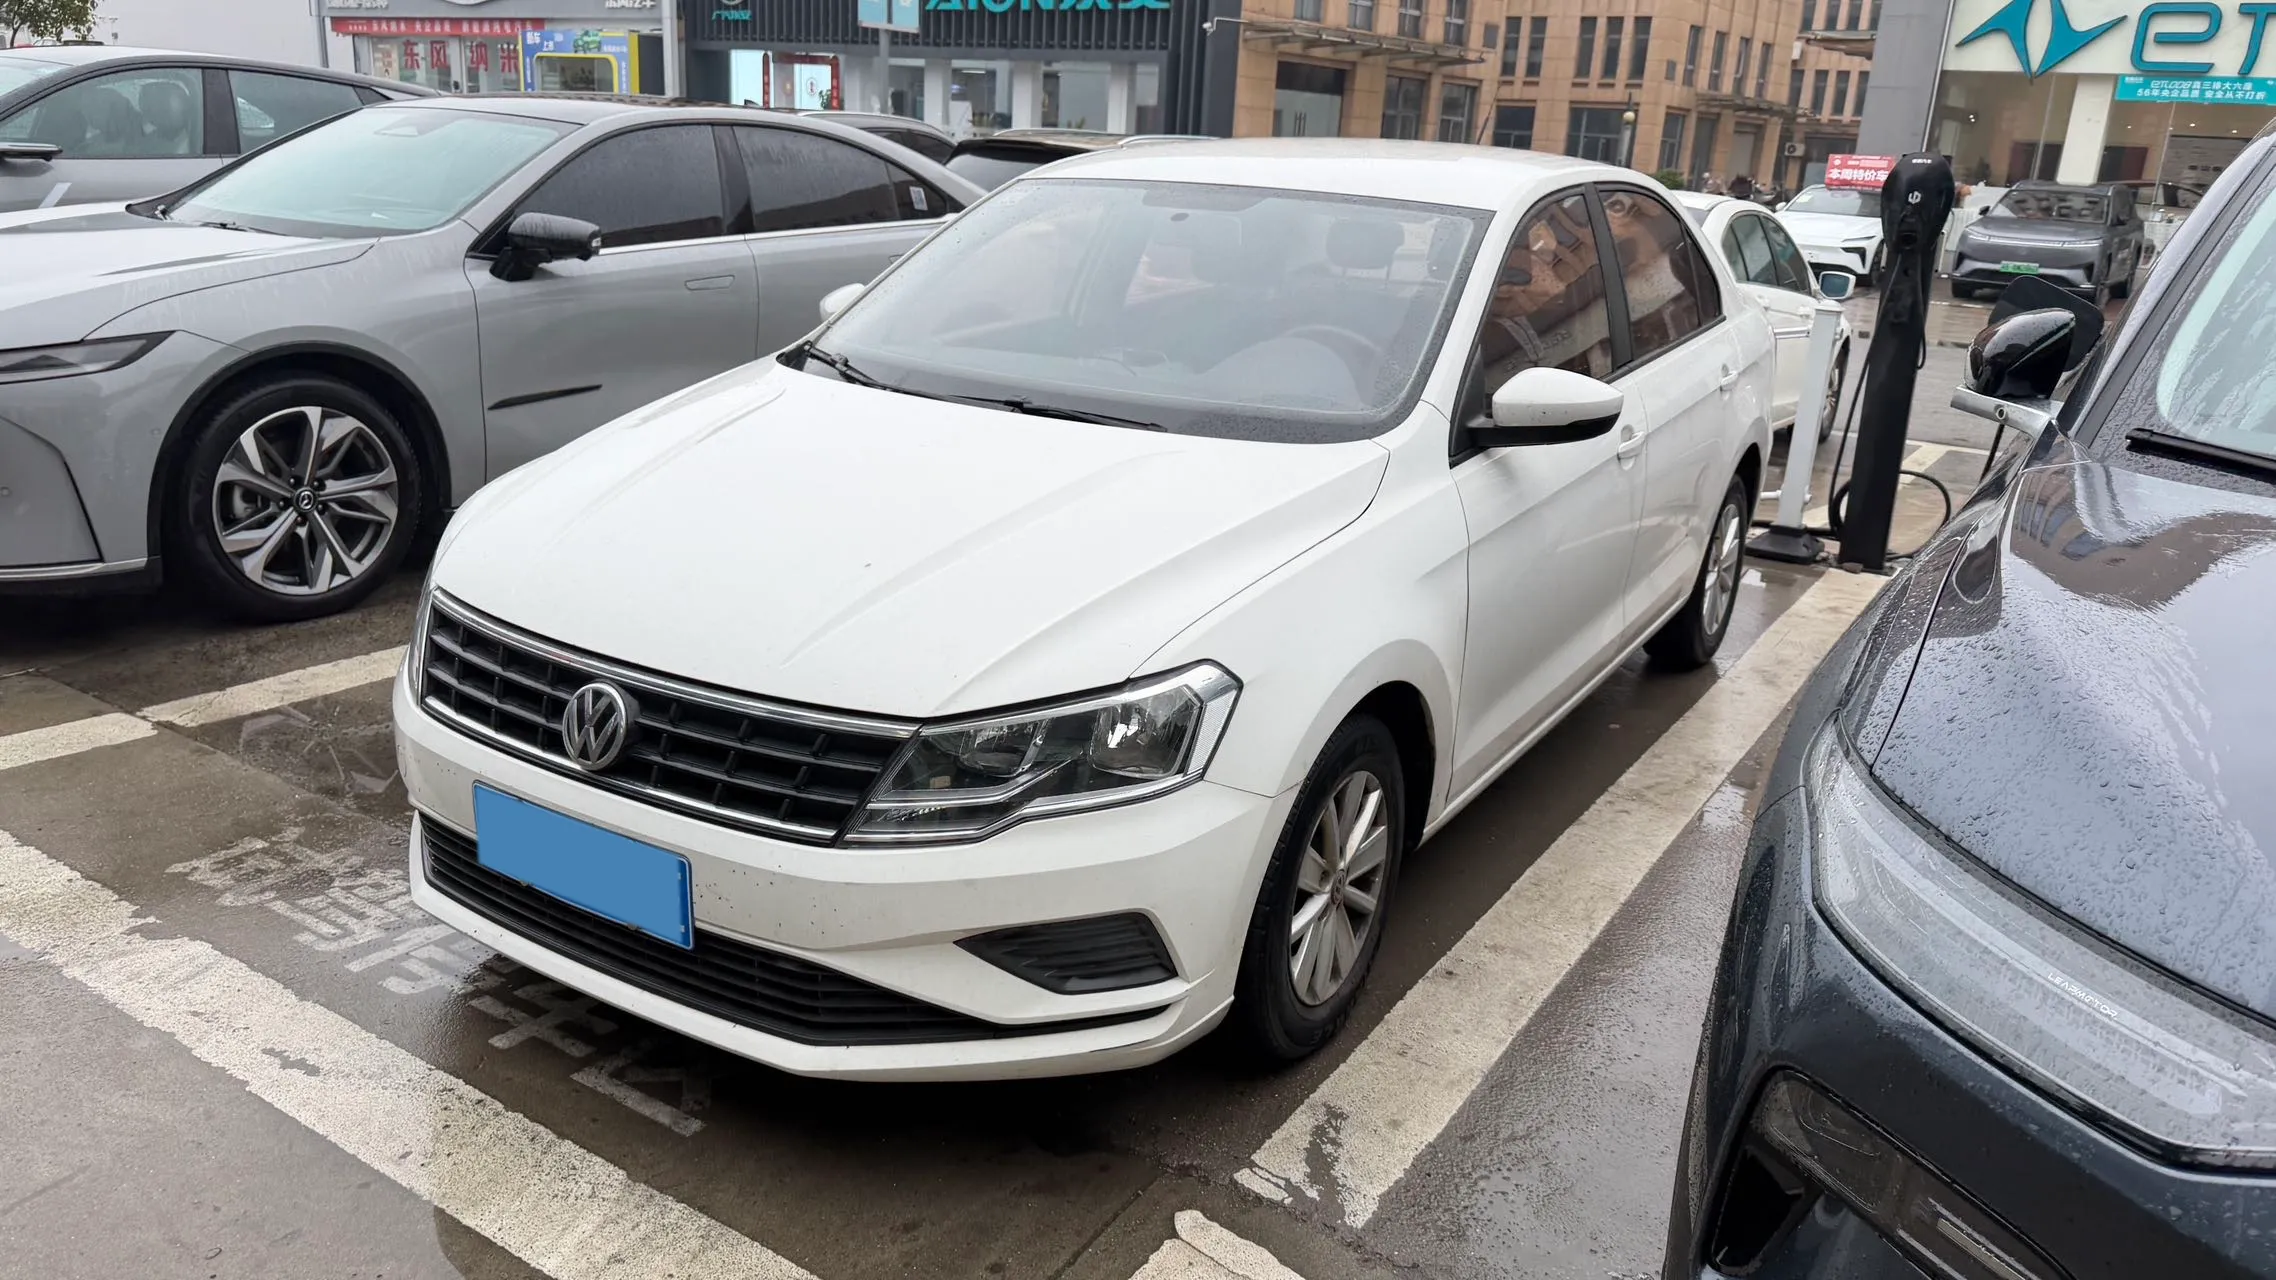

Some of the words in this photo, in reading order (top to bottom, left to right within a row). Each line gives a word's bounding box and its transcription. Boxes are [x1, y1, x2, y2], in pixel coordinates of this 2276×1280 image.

[403, 39, 519, 73] 东风纳米
[1829, 168, 1889, 182] 本周特价车
[2047, 972, 2118, 1019] LEAPMOTOR
